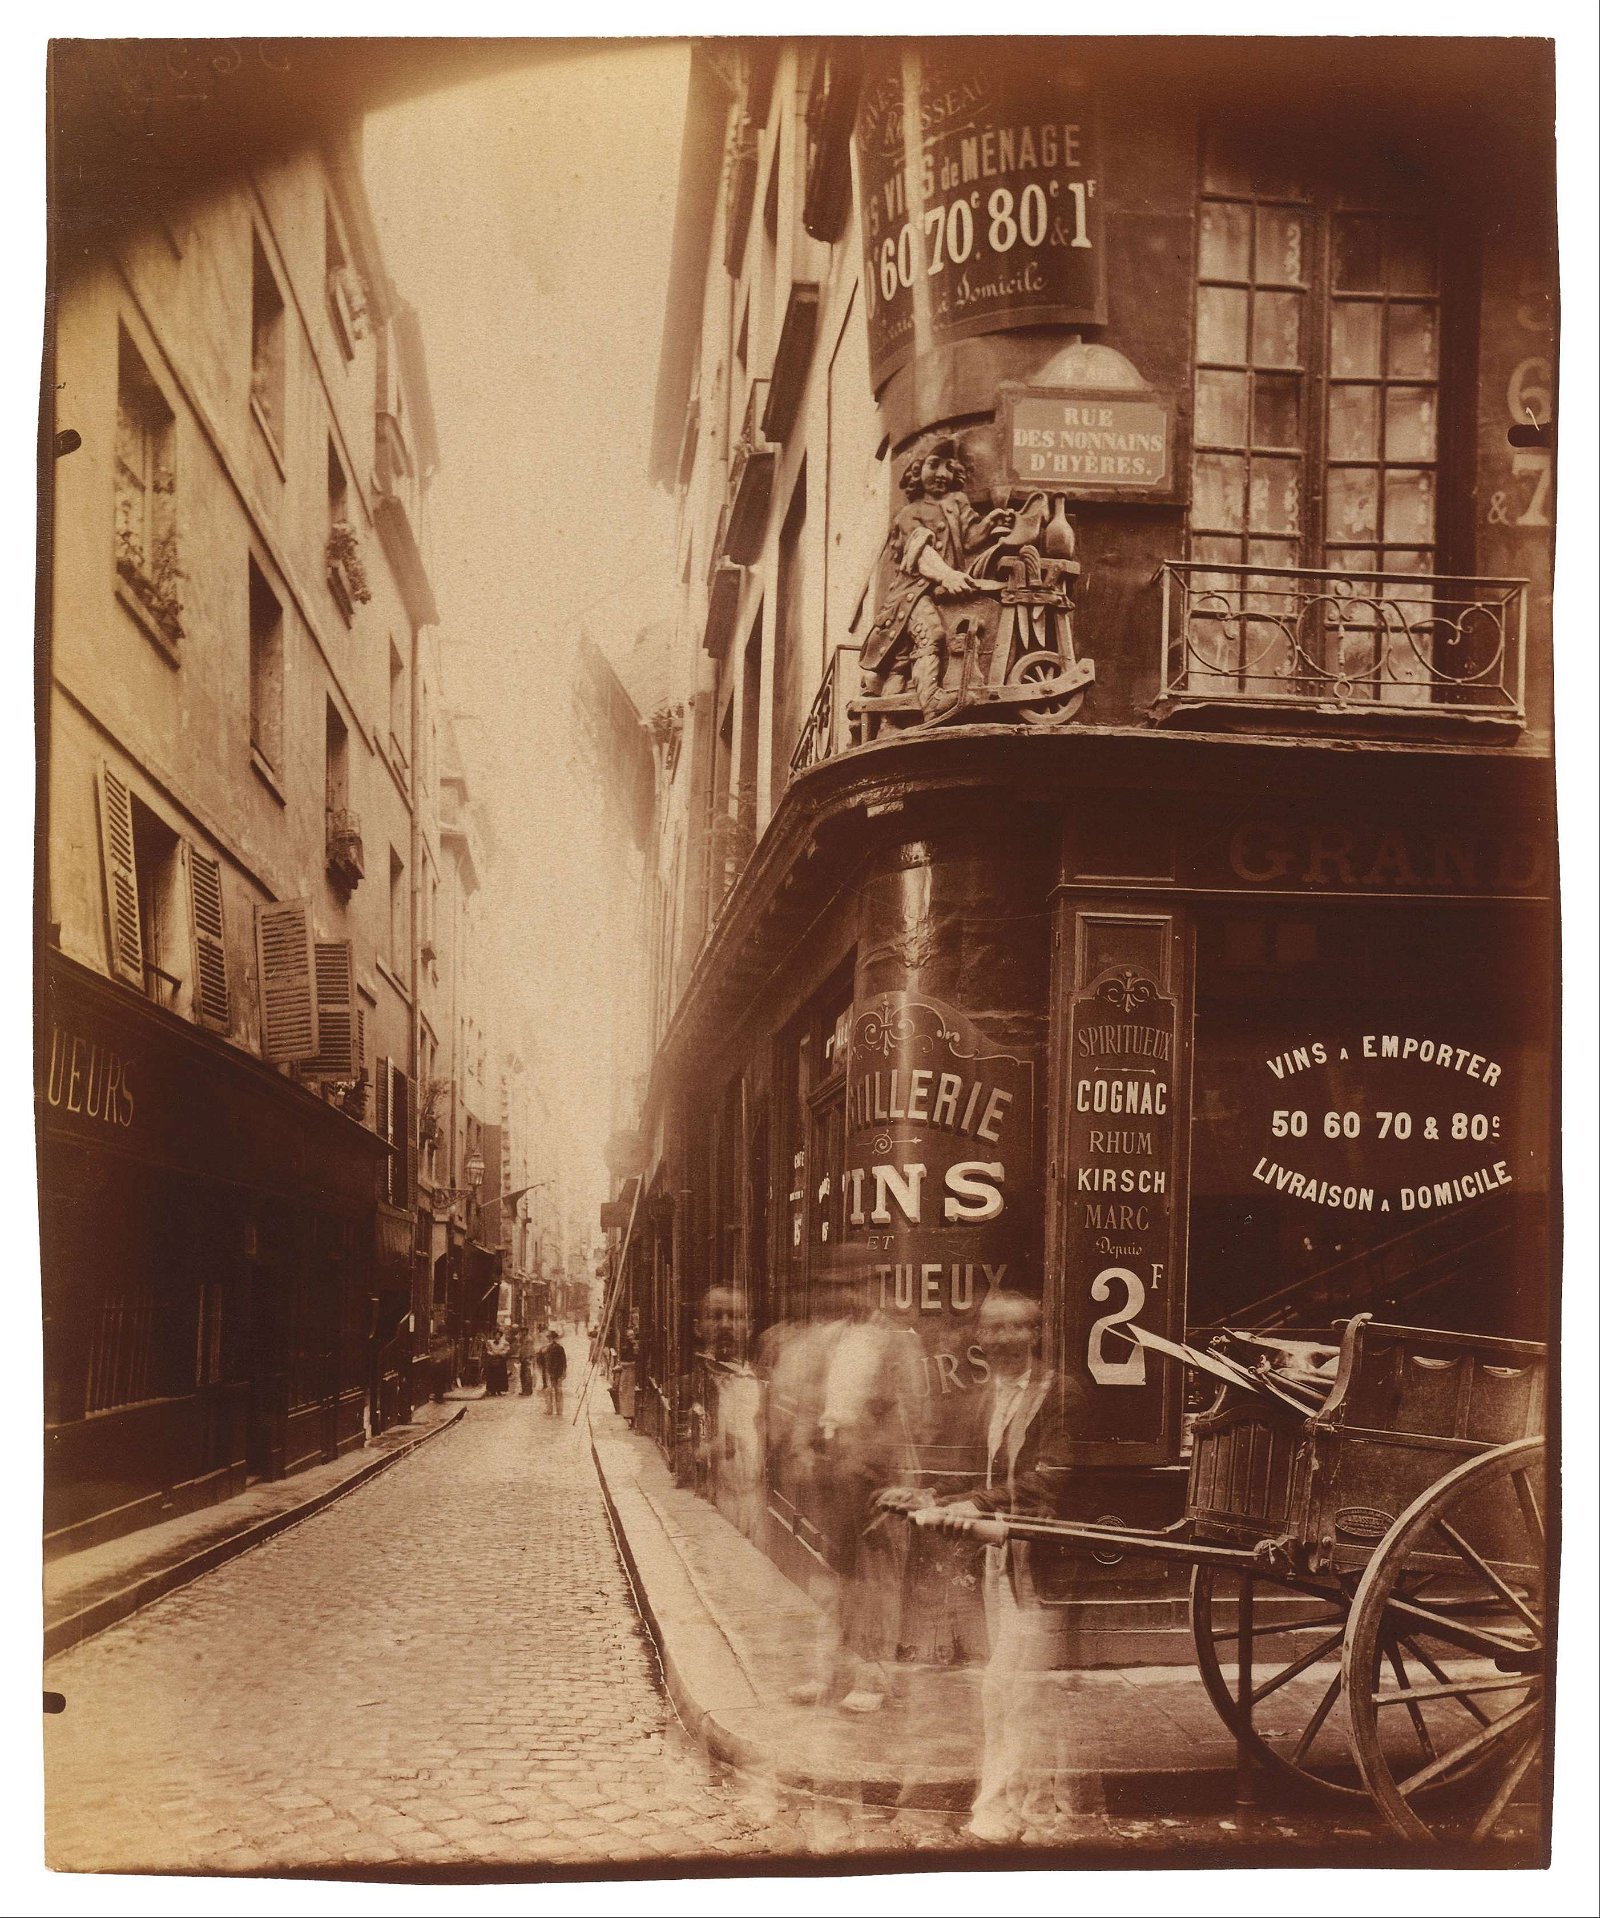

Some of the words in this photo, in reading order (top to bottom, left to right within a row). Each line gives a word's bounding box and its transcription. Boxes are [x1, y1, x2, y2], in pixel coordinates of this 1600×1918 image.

[941, 155, 959, 191] de
[961, 124, 1082, 183] MÉNAGE
[1064, 407, 1113, 428] RUE
[1013, 429, 1055, 448] DES
[1060, 430, 1163, 452] NONNAINS
[1488, 491, 1511, 526] &
[1229, 821, 1547, 888] GRAND
[1078, 1024, 1172, 1061] SPIRITUEUX
[48, 1027, 136, 1127] UEURS
[1266, 1042, 1328, 1079] VINS
[1362, 1035, 1502, 1087] EMPORTER
[1076, 1079, 1167, 1115] COGNAC
[1271, 1110, 1308, 1138] 50
[1323, 1111, 1361, 1139] 60
[1376, 1111, 1412, 1140] 70
[1423, 1116, 1440, 1140] &
[1089, 1130, 1153, 1155] RHUM
[1077, 1167, 1166, 1194] KIRSCH
[1252, 1156, 1374, 1211] LIVRAISON
[1400, 1160, 1513, 1211] DOMICILE
[1084, 1204, 1149, 1231] MARC
[866, 1235, 894, 1250] ET
[1095, 1236, 1143, 1260] Depuis
